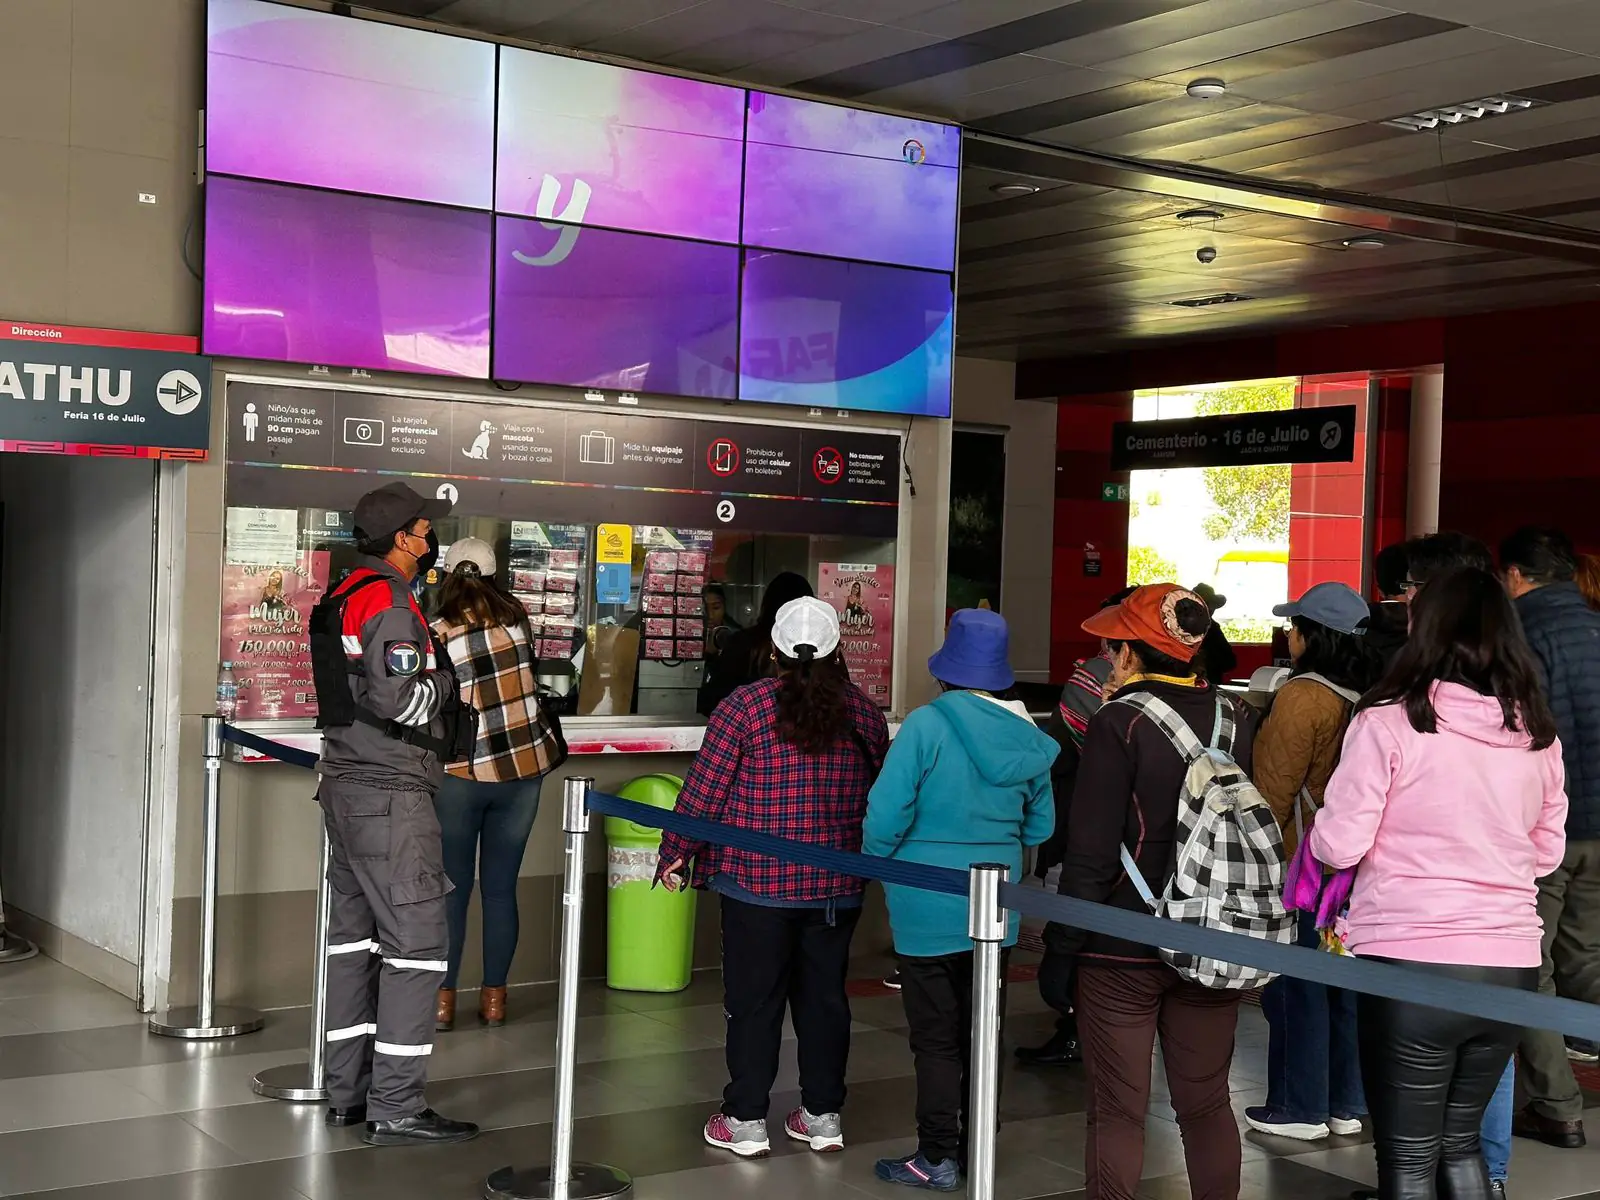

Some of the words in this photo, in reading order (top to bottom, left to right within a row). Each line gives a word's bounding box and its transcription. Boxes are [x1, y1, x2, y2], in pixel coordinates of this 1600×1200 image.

[512, 173, 592, 266] y
[12, 326, 62, 338] Dirección
[0, 361, 132, 406] ATHU
[268, 404, 299, 415] Niño/as
[301, 407, 316, 416] que
[64, 411, 89, 420] Feria
[93, 412, 104, 421] 16
[107, 413, 119, 421] de
[122, 413, 146, 423] Julio
[268, 415, 293, 424] midan
[295, 415, 311, 425] más
[313, 418, 323, 426] de
[392, 415, 402, 423] La
[404, 416, 428, 426] tarjeta
[268, 424, 279, 432] 90
[281, 425, 294, 434] cm
[295, 427, 320, 436] pagan
[359, 426, 369, 437] T
[392, 425, 438, 436] preferencial
[523, 425, 537, 433] con
[537, 425, 545, 434] tu
[267, 434, 293, 444] pasaje
[403, 436, 412, 444] de
[503, 434, 535, 443] mascota
[1126, 431, 1207, 452] Cementerio
[1223, 429, 1241, 446] 16
[1246, 428, 1266, 444] de
[1271, 425, 1310, 443] Julio
[392, 446, 426, 455] exclusivo
[502, 444, 528, 453] usando
[530, 446, 553, 454] correa
[623, 442, 641, 451] Mide
[642, 444, 651, 452] tu
[651, 445, 683, 455] equipaje
[746, 448, 776, 457] Prohibido
[509, 453, 529, 461] bozal
[655, 456, 684, 464] ingresar
[849, 452, 858, 460] No
[859, 453, 885, 461] consumir
[746, 458, 756, 466] uso
[769, 459, 791, 468] celular
[849, 461, 870, 470] bebidas
[857, 478, 866, 486] las
[866, 478, 886, 487] cabinas
[721, 504, 730, 518] 2
[303, 529, 331, 537] Descarga
[393, 649, 415, 669] T
